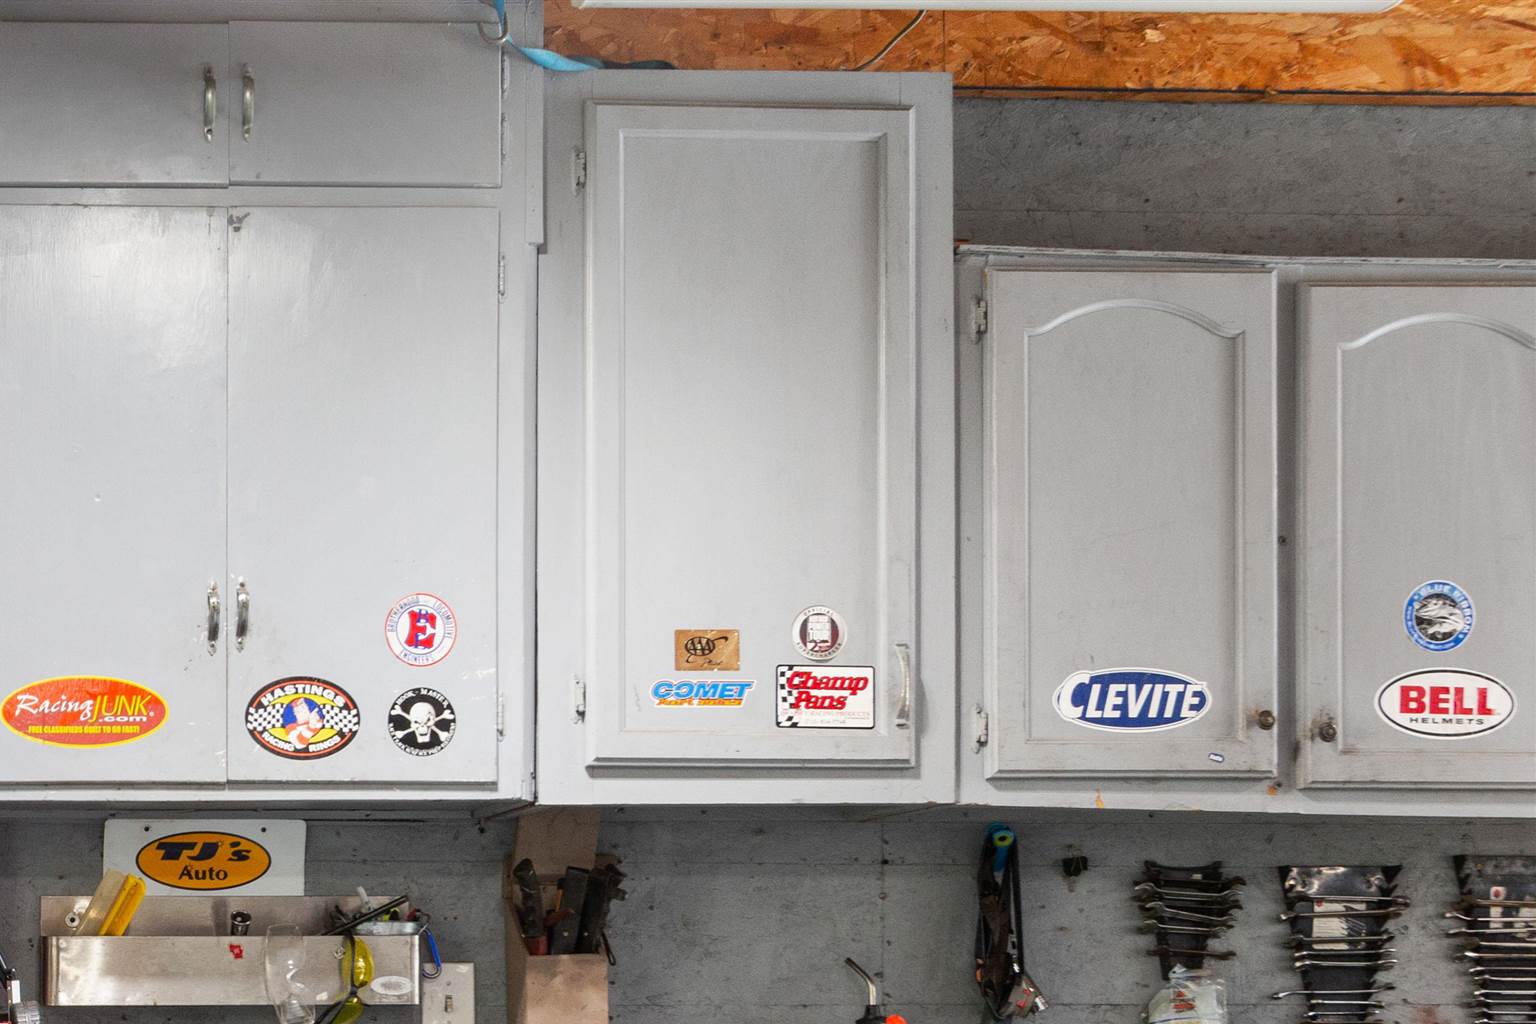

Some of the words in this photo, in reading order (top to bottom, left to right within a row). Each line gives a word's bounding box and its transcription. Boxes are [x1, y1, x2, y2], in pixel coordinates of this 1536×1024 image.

[432, 600, 454, 639] LOCOMOTIVE
[651, 680, 754, 700] COMET
[786, 671, 870, 696] Champ
[261, 683, 346, 708] HASTINGS
[790, 690, 849, 710] Pans
[1058, 673, 1207, 720] CLEVITE
[1399, 685, 1497, 716] BELL
[1409, 717, 1484, 725] HELMETS
[261, 731, 296, 752] RACING
[308, 735, 342, 752] RINGS
[156, 841, 252, 862] TJ's
[178, 865, 228, 881] Auto
